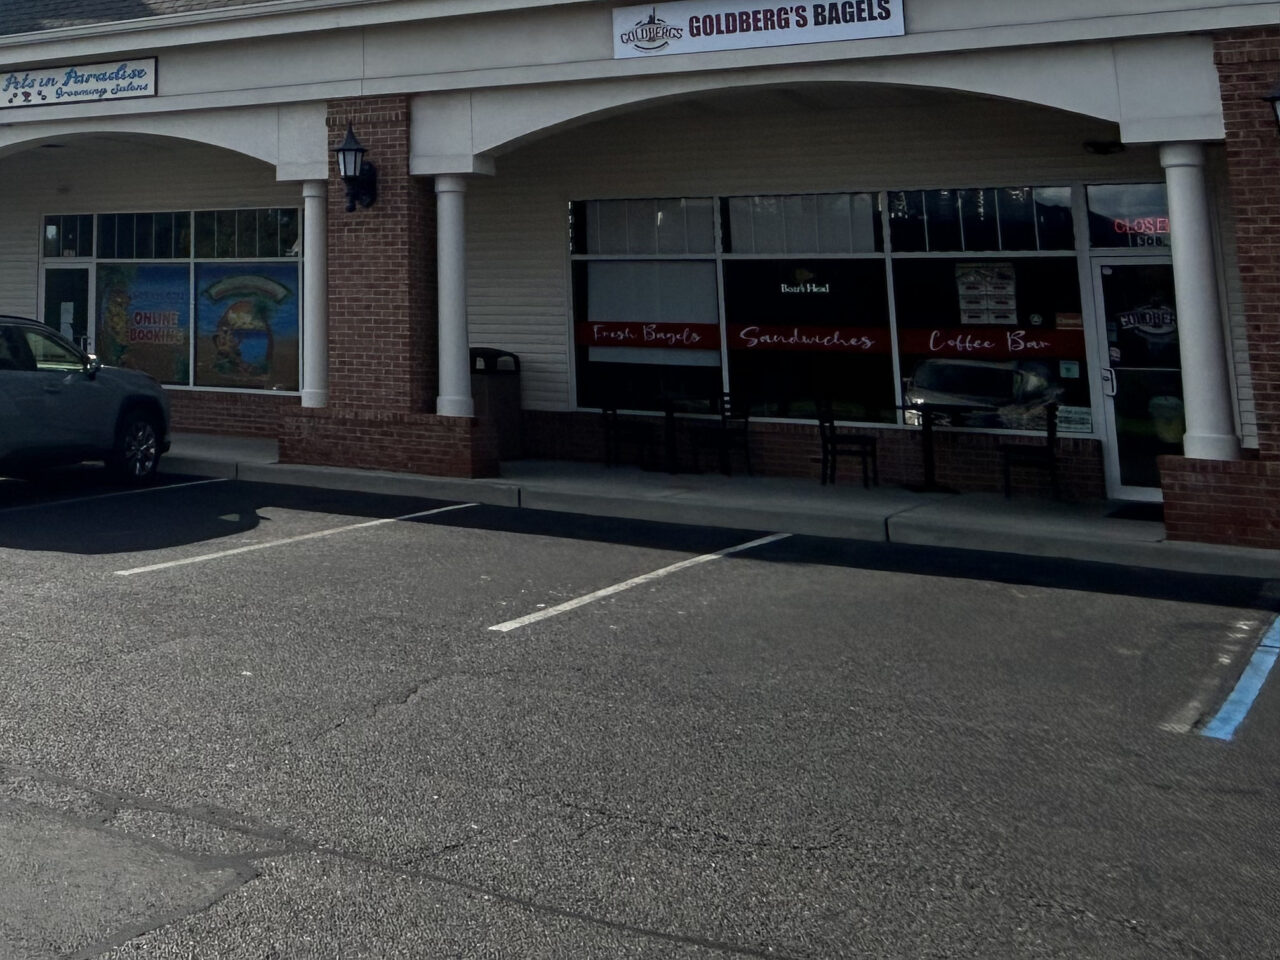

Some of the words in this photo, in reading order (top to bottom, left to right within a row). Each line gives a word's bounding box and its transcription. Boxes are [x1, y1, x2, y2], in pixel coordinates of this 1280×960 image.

[688, 5, 808, 37] GOLDBERG'S
[2, 73, 37, 91] Pets
[39, 77, 58, 88] in
[62, 63, 147, 86] Paradise
[55, 87, 107, 99] Grooming
[1114, 218, 1170, 233] CLOSE
[807, 283, 830, 293] Head
[134, 311, 179, 326] ONLINE
[593, 324, 635, 341] Fresh
[643, 324, 702, 344] Bagels
[739, 326, 876, 349] Sandwiches
[929, 330, 995, 351] Coffee
[1007, 330, 1051, 352] Bar
